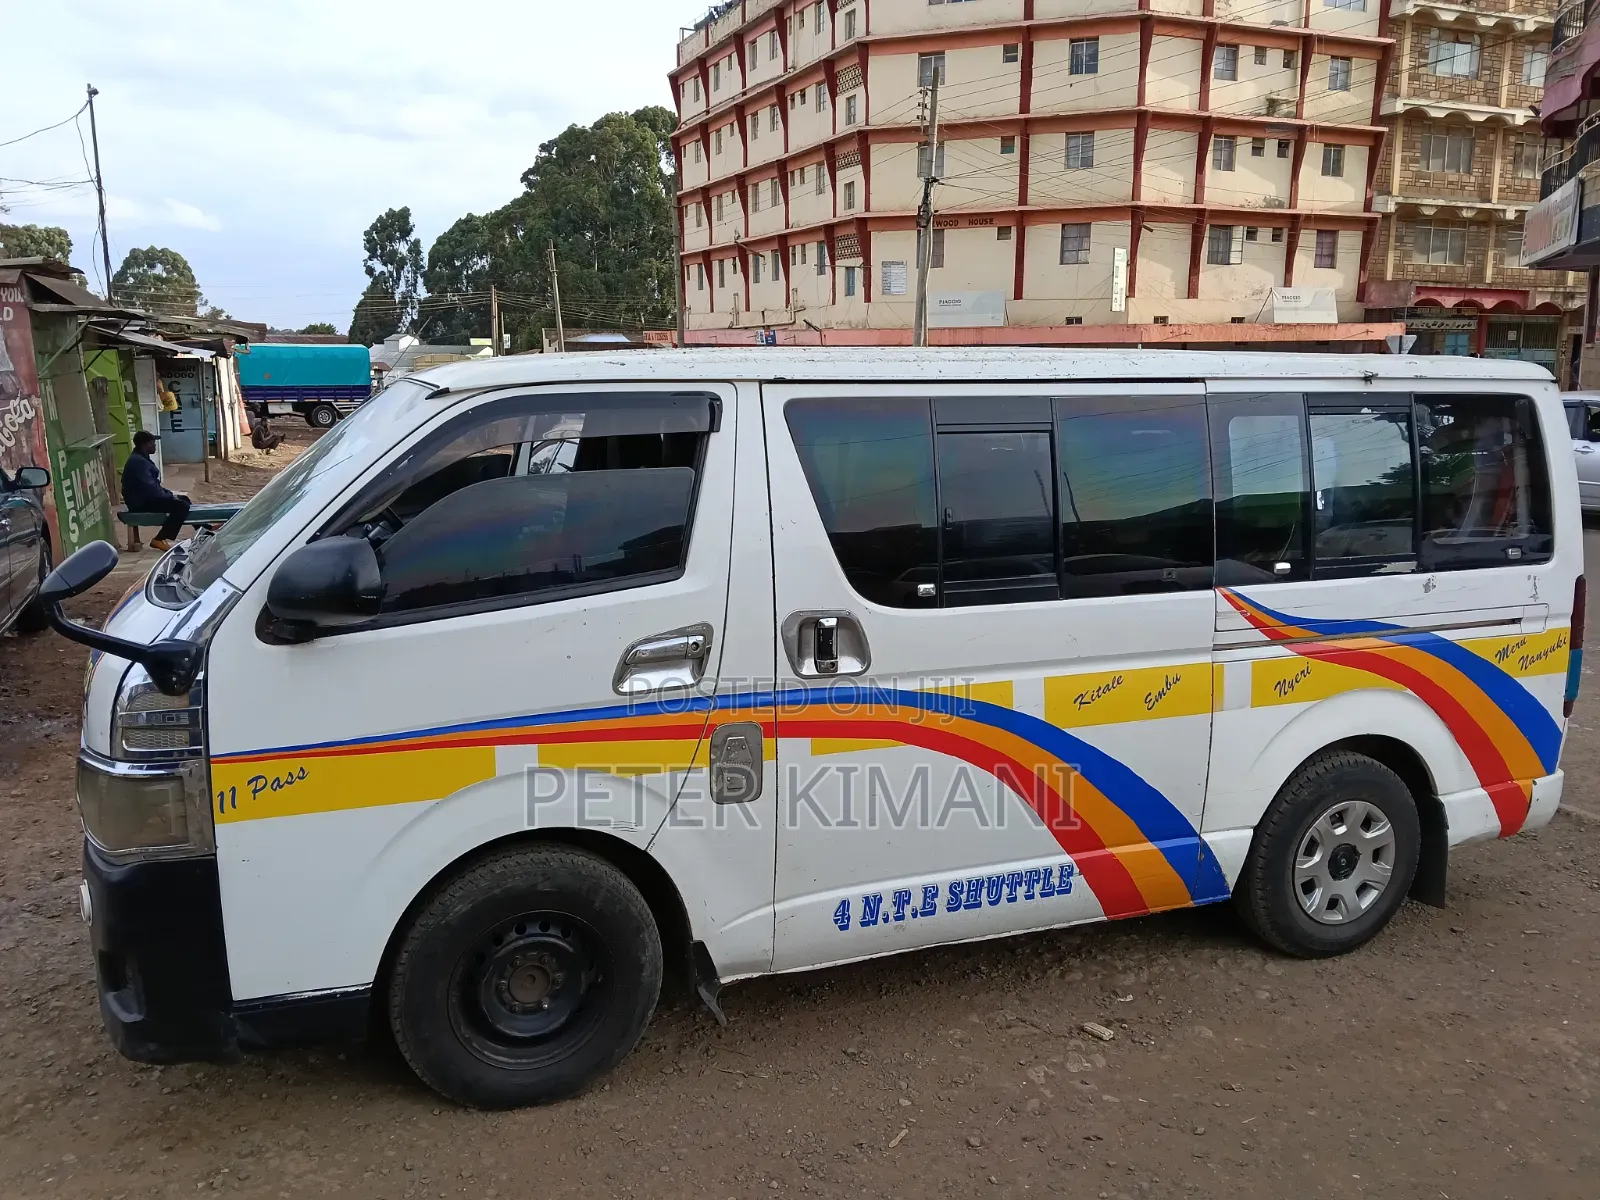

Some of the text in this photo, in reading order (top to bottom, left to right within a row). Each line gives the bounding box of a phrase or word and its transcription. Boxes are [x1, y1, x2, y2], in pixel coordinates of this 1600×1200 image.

[1494, 636, 1528, 664] Meru
[1517, 631, 1568, 672] Nanyuki
[1073, 674, 1125, 711] Kitale
[1144, 672, 1182, 711] Embu
[1273, 661, 1312, 698] Nyeri
[216, 766, 310, 814] 11 Pass
[833, 862, 1074, 931] 4 N.T.E SHUTTLE
